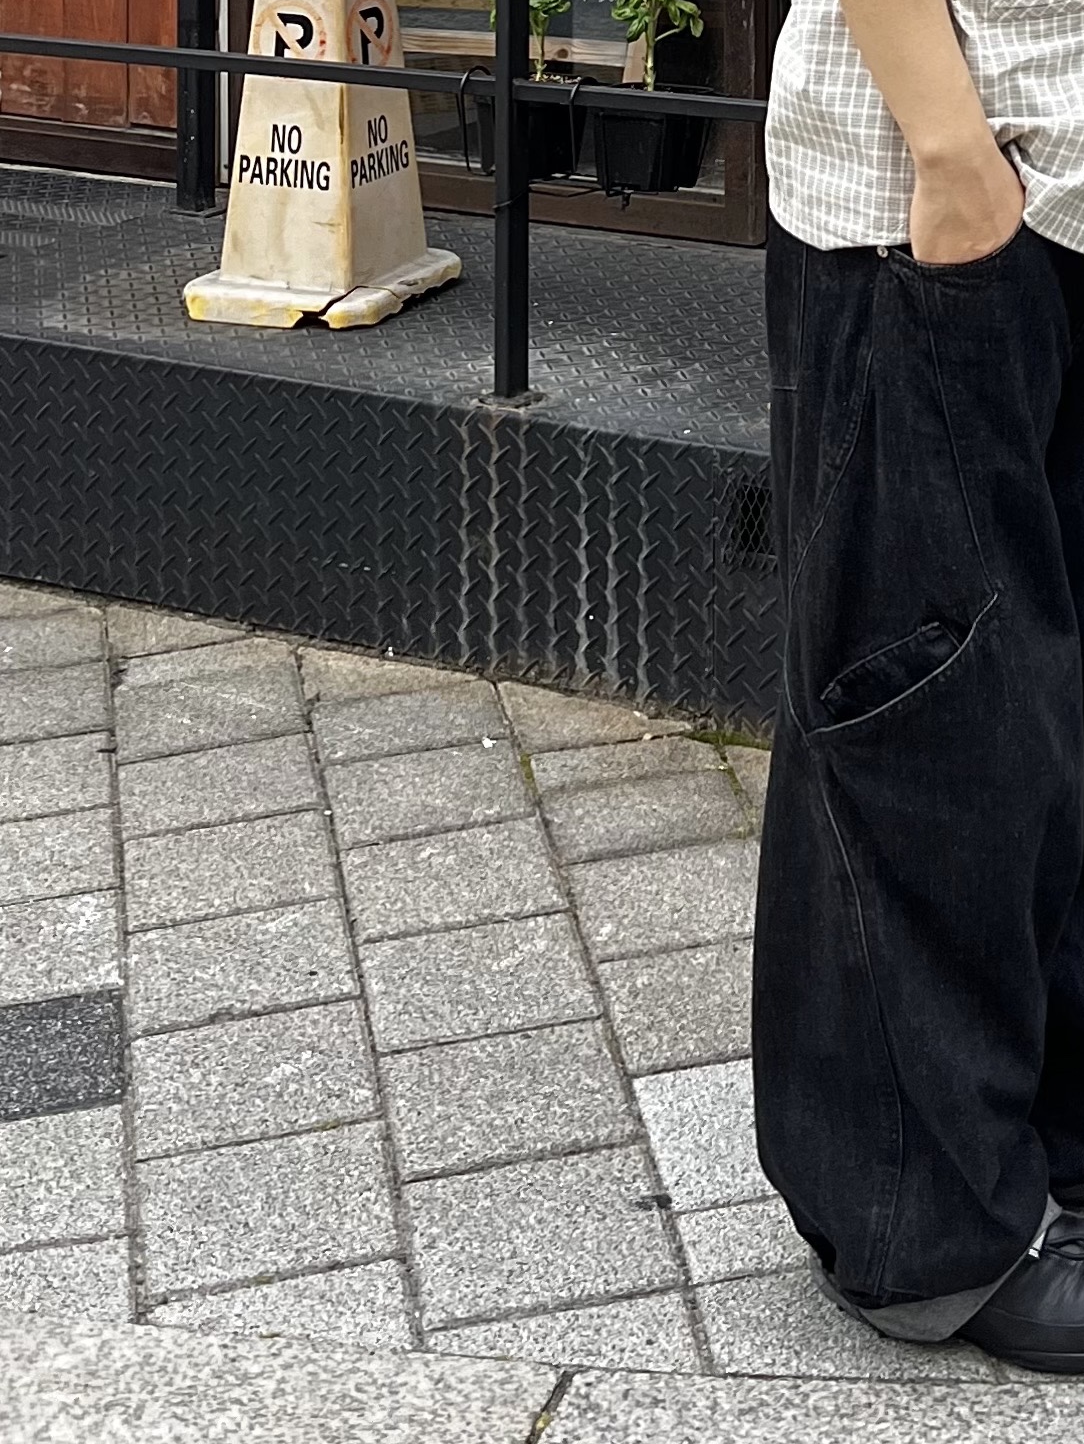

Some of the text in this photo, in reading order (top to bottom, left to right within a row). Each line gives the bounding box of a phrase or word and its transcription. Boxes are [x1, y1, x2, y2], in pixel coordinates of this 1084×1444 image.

[270, 123, 302, 154] NO
[367, 114, 389, 149] NO
[238, 154, 331, 191] PARKING
[350, 139, 410, 189] PARKING
